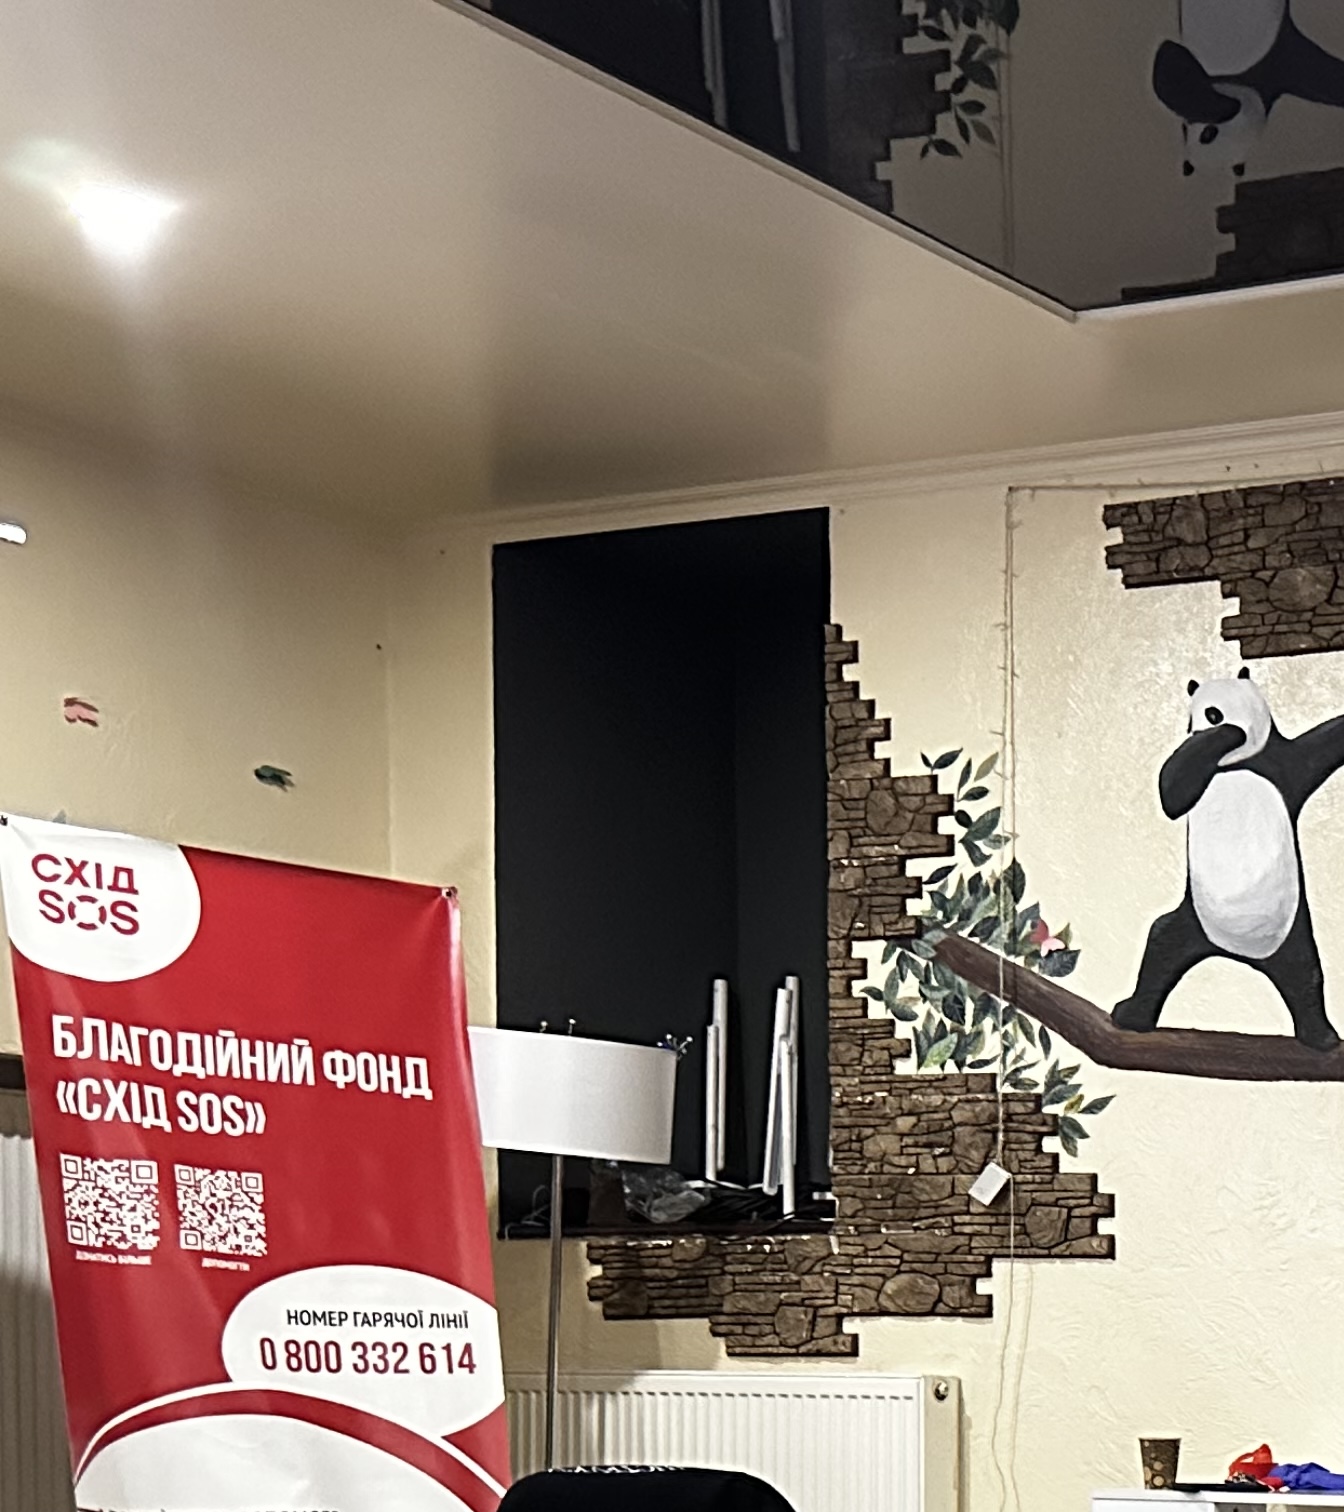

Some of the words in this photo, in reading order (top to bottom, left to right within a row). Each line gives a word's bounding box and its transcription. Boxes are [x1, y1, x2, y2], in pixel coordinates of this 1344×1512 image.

[31, 853, 139, 895] СХІД
[38, 889, 140, 936] SOS
[52, 1014, 316, 1086] БЛАГОДІЙНИЙ
[322, 1049, 433, 1101] ФОНД
[56, 1078, 173, 1134] «СХІД
[176, 1090, 267, 1137] SOS»
[286, 1309, 348, 1327] НОМЕР
[353, 1310, 424, 1329] ГАРЯЧОЇ
[428, 1310, 469, 1329] ЛІНІЇ
[260, 1337, 277, 1371] 0
[284, 1339, 342, 1374] 800
[351, 1341, 410, 1374] 332
[418, 1342, 477, 1374] 614
